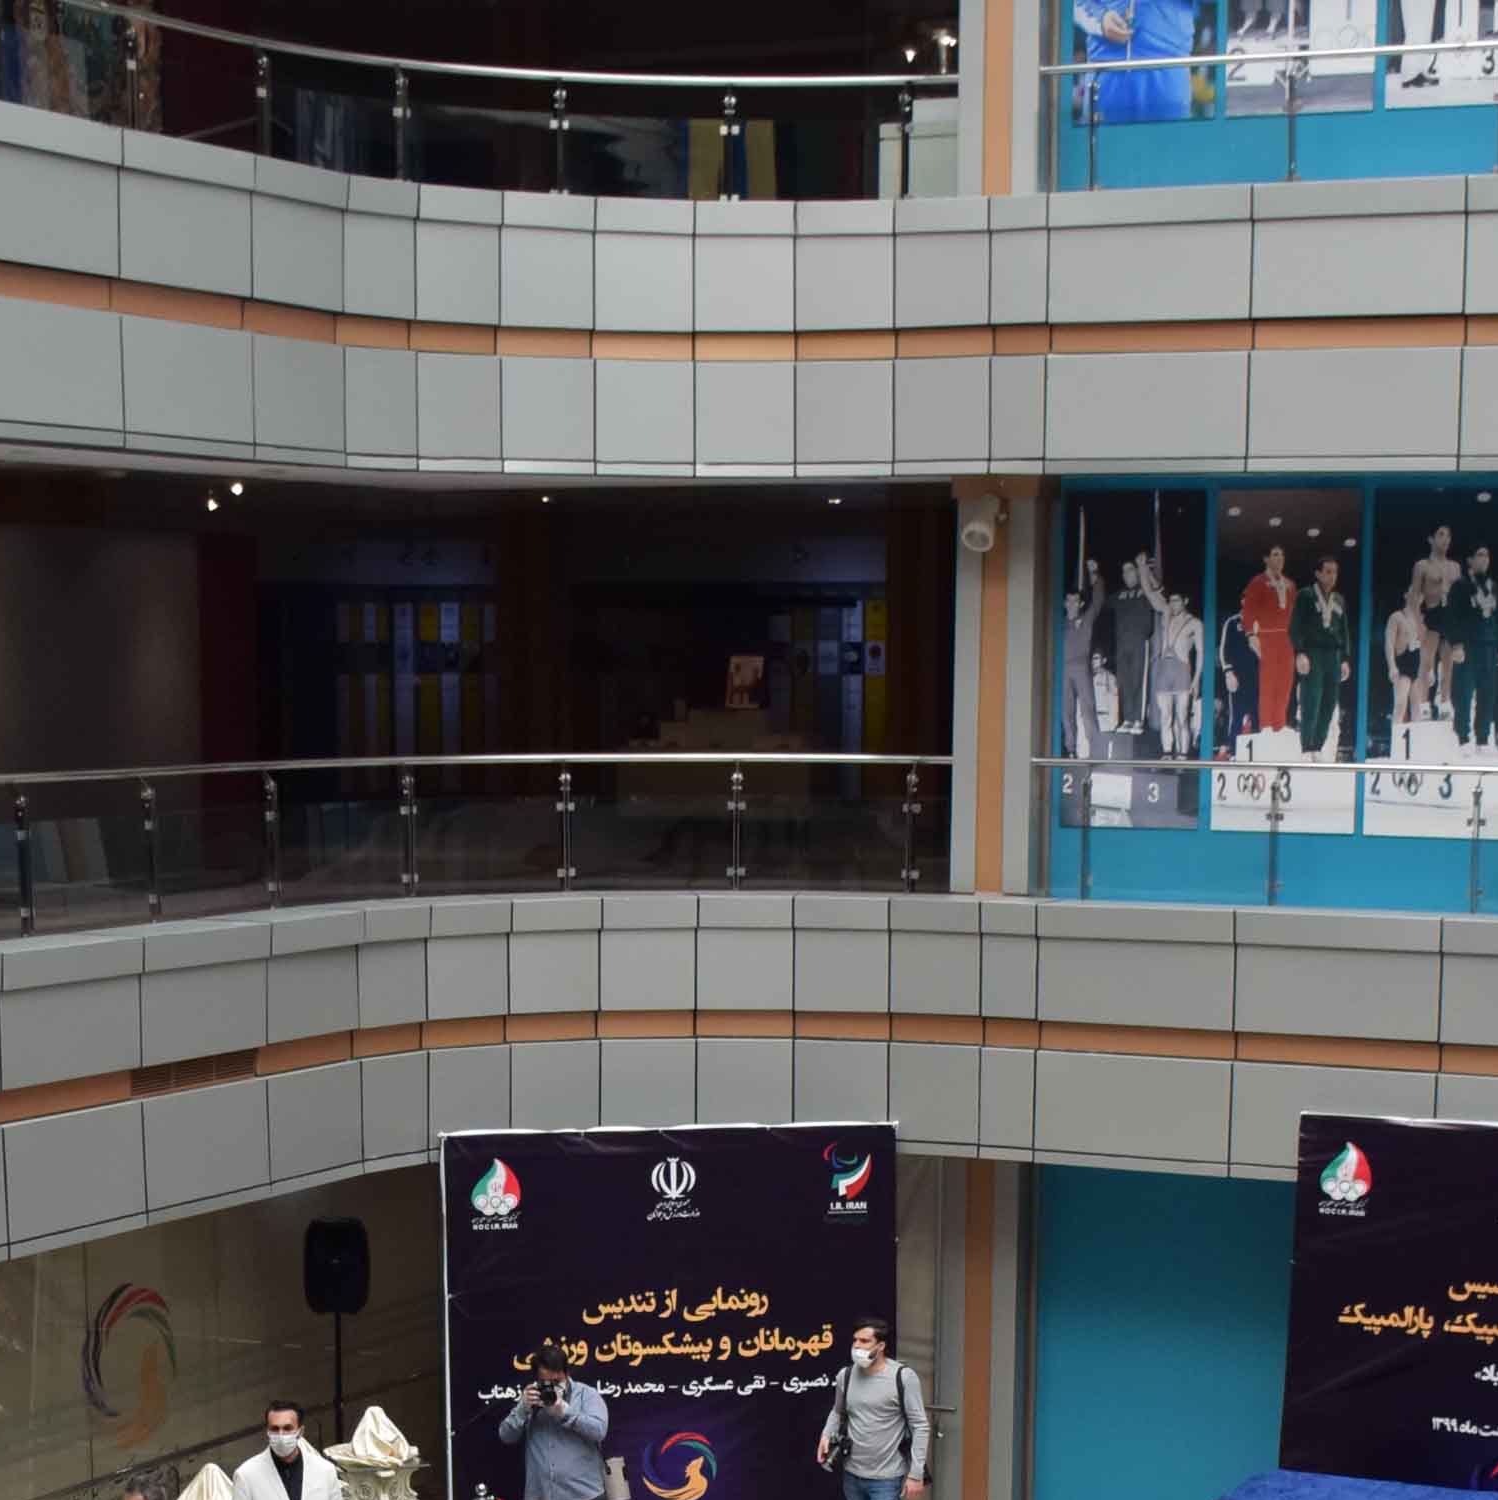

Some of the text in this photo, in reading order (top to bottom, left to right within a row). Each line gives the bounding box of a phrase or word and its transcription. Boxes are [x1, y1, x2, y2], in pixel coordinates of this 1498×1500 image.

[1401, 728, 1411, 761] 1
[1062, 772, 1074, 794] 2
[1147, 783, 1160, 802] 3
[1217, 772, 1227, 801] 2
[582, 1286, 769, 1325] رونمایی از تندیس
[1338, 1303, 1434, 1339] پارالمپیک
[595, 1332, 714, 1366] پیشکسوتان
[718, 1335, 731, 1361] و
[737, 1323, 834, 1361] قهرمانان
[596, 1379, 622, 1398] رضا
[623, 1379, 666, 1394] محمد
[783, 1373, 830, 1393] نصیری
